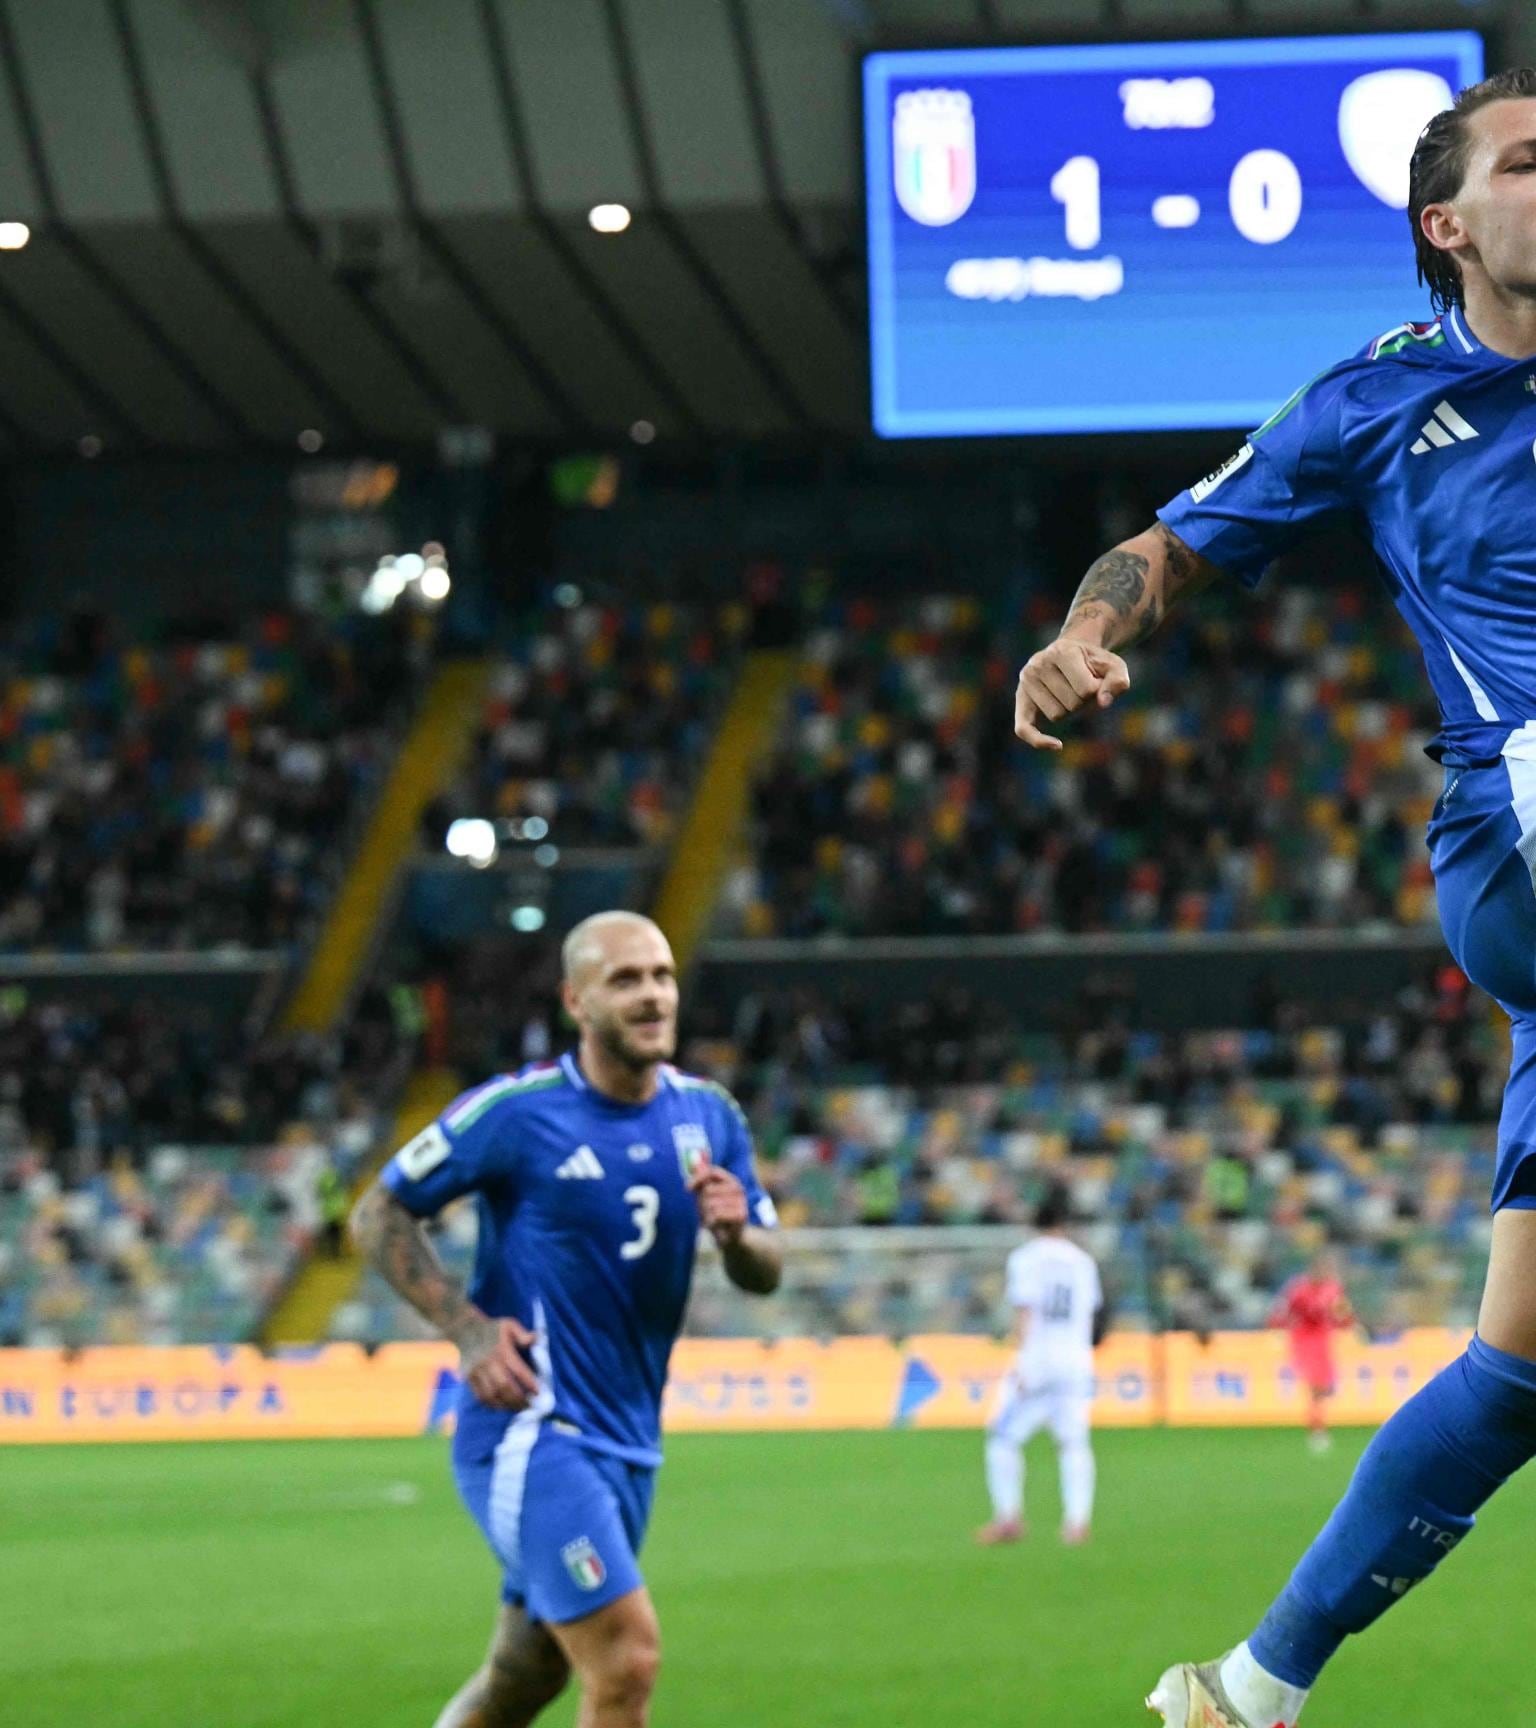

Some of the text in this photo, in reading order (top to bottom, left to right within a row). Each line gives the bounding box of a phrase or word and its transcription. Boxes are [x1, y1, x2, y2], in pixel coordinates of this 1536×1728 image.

[1051, 156, 1100, 249] 1
[1229, 149, 1301, 243] 0
[620, 1185, 660, 1260] 3
[60, 1383, 284, 1417] EUROPA
